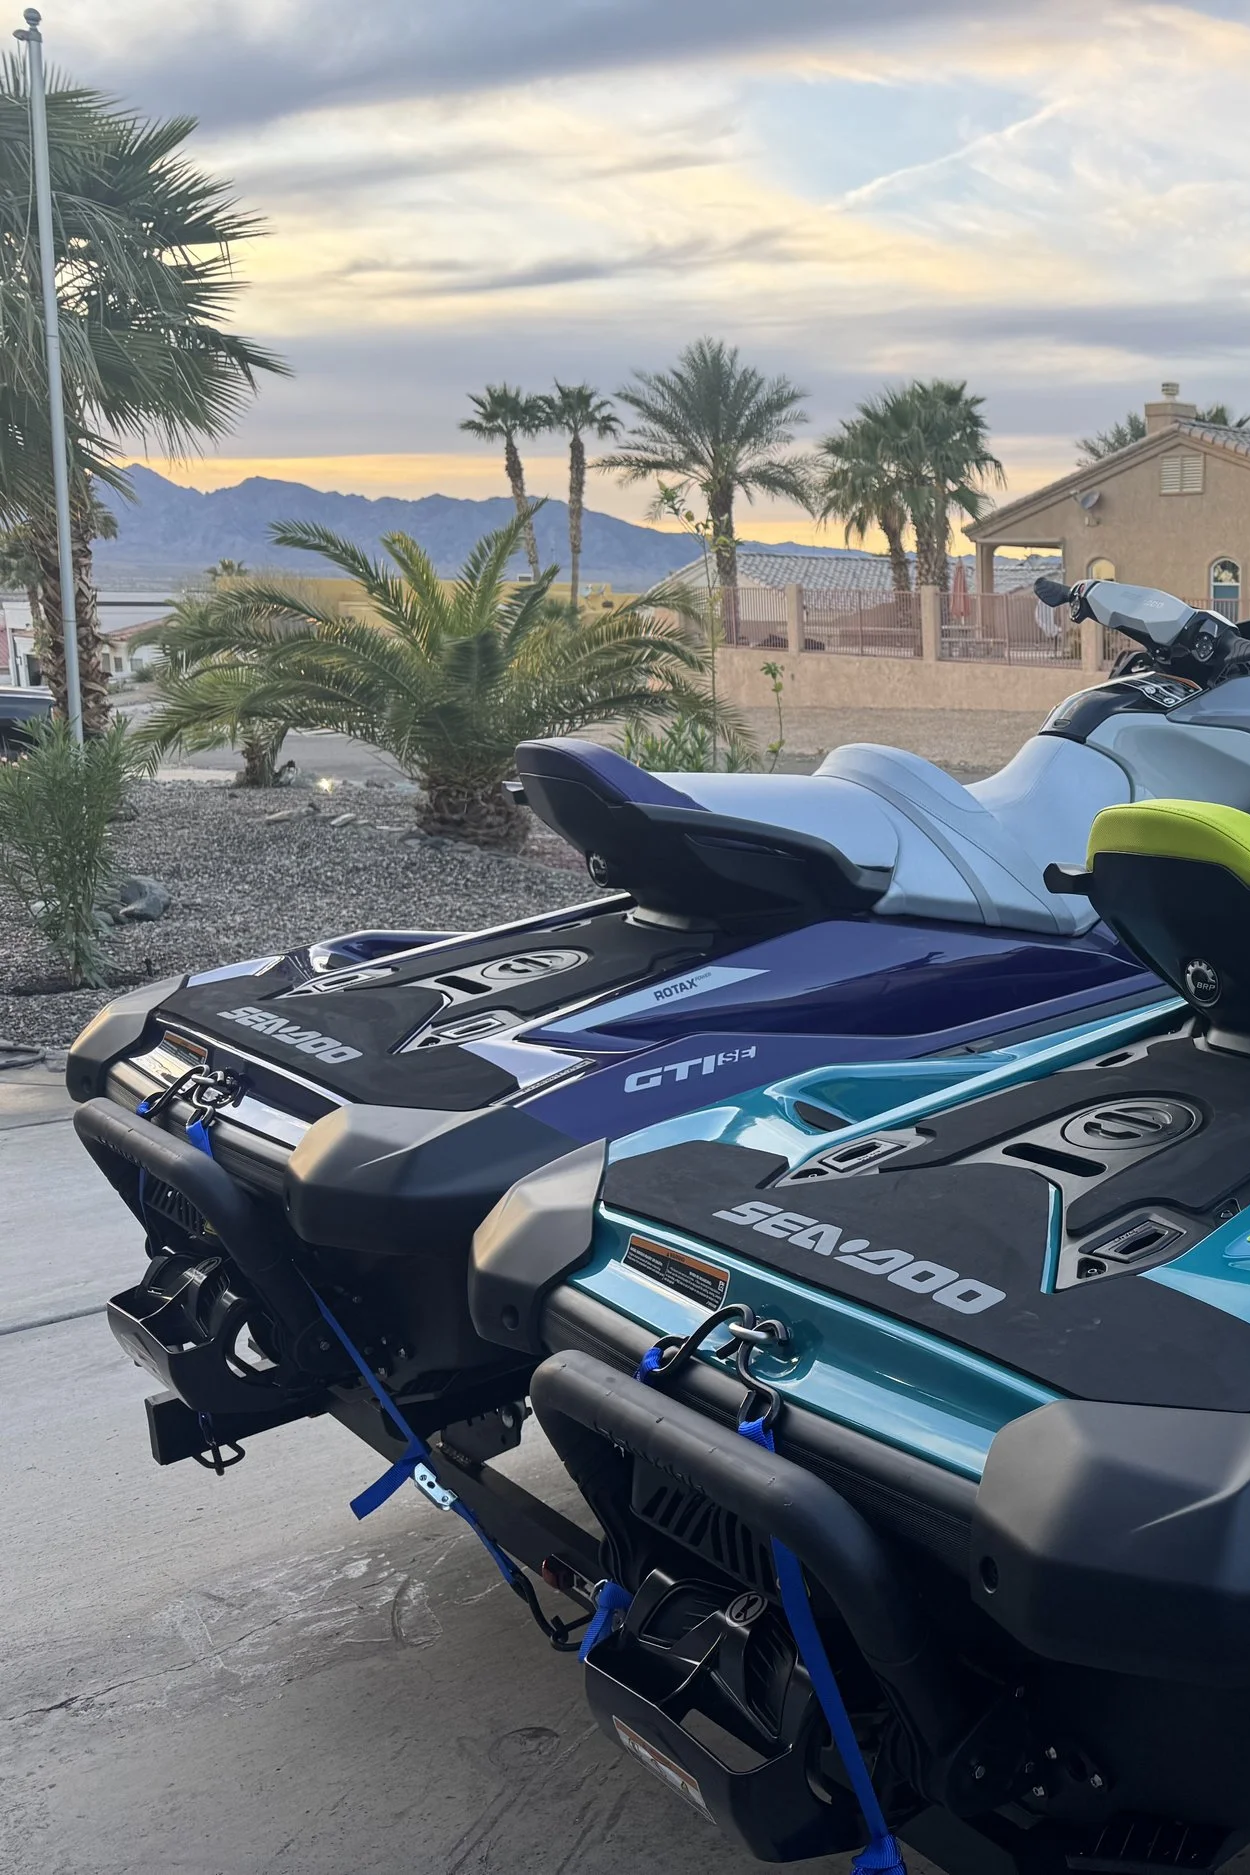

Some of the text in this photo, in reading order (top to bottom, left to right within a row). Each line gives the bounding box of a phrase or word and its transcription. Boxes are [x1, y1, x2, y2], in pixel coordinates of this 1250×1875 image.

[653, 978, 698, 1001] ROTAX
[1196, 981, 1216, 991] BRP
[624, 1054, 716, 1093] GTI
